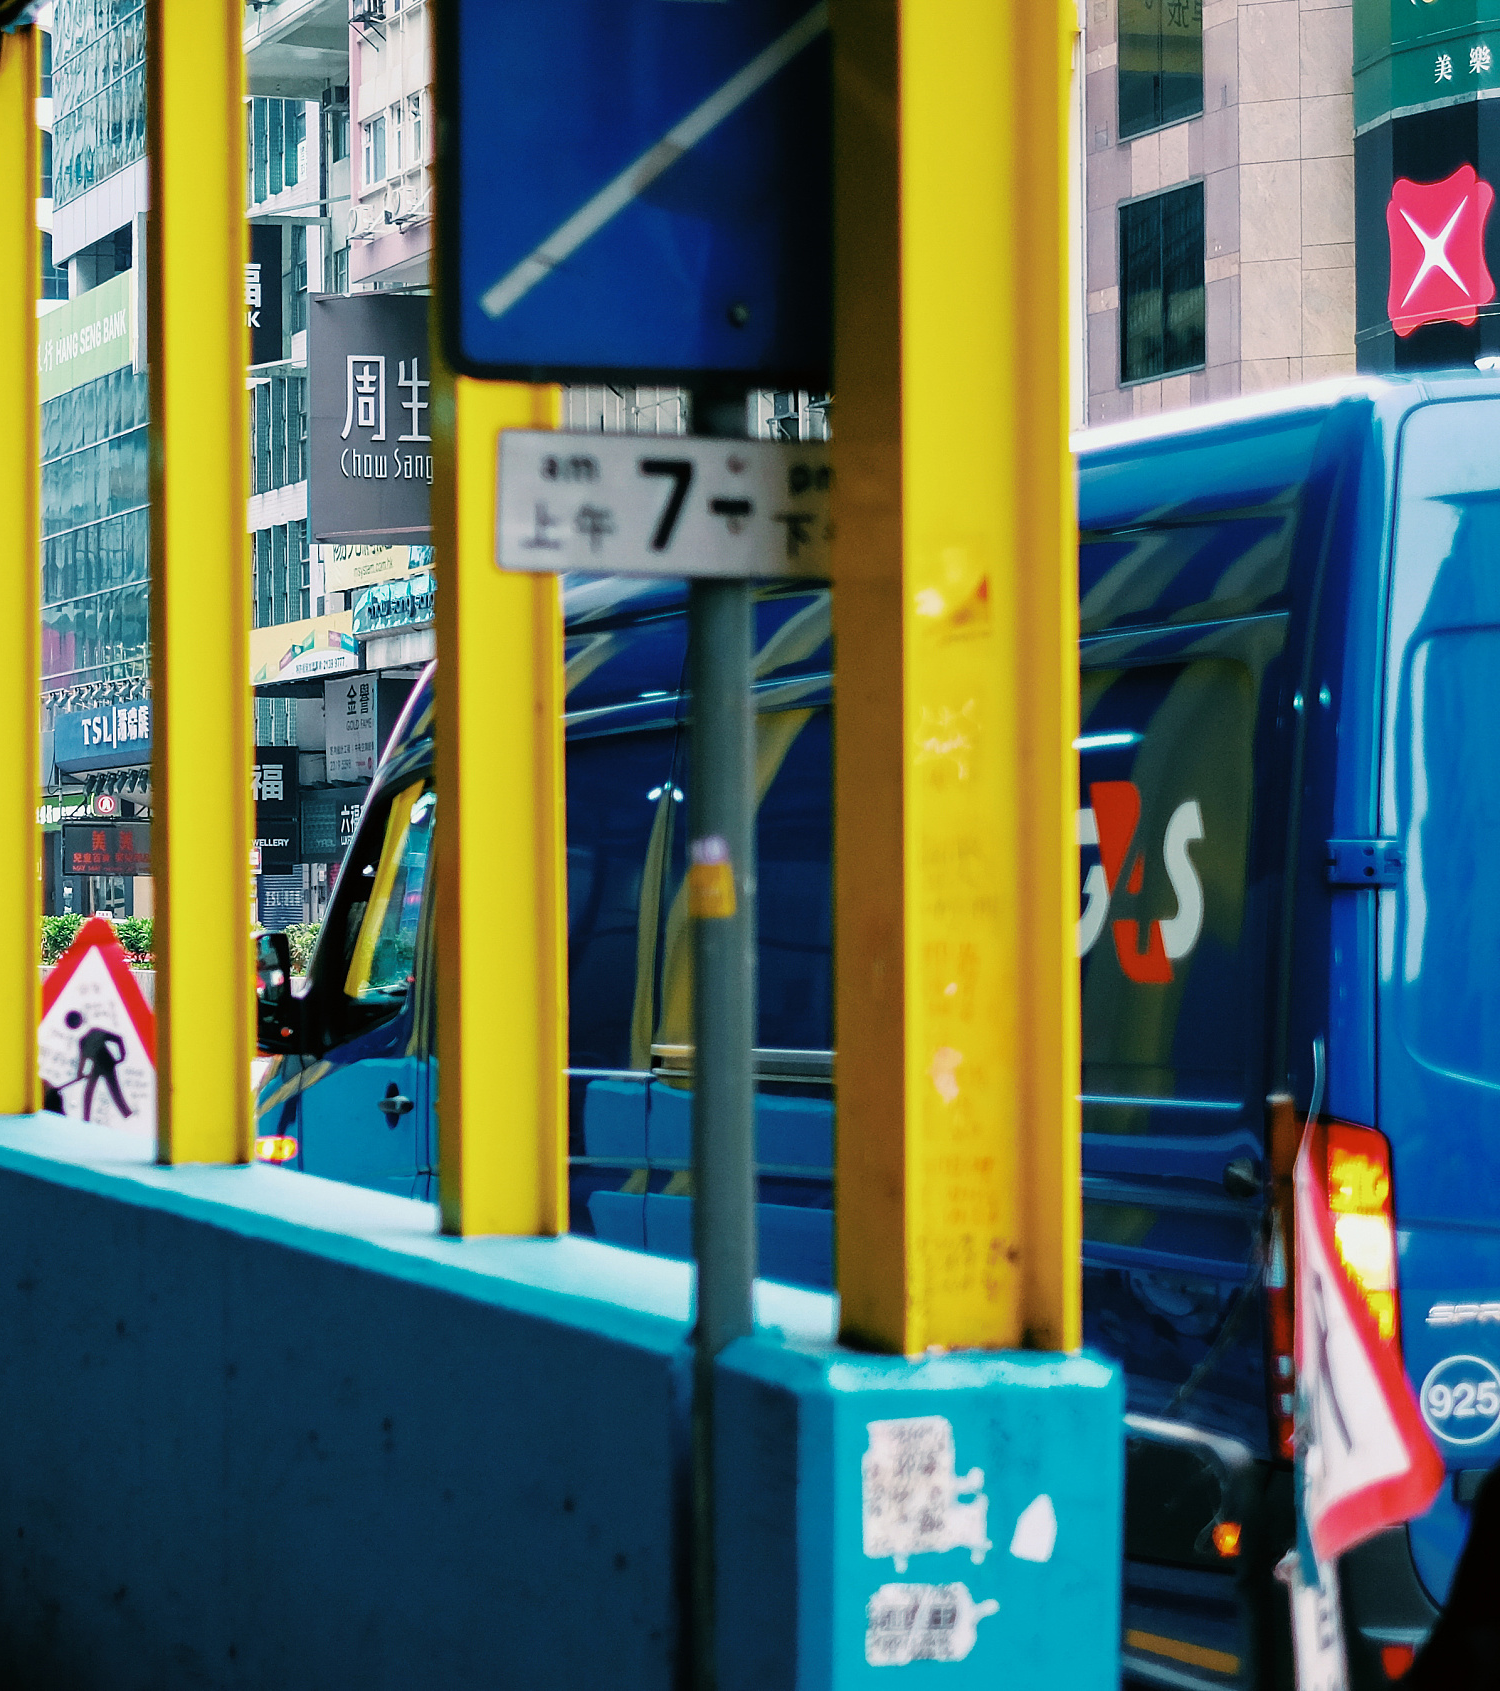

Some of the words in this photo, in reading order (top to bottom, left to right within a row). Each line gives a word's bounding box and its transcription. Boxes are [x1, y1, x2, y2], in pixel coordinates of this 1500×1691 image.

[56, 332, 78, 366] HANG
[80, 320, 101, 355] SENG
[103, 308, 127, 344] BANK
[340, 355, 433, 441] 周生
[340, 448, 388, 478] Chow
[393, 448, 434, 485] Sang
[346, 683, 375, 716] 金譽
[81, 715, 113, 746] TSL
[1428, 1382, 1499, 1418] 925
